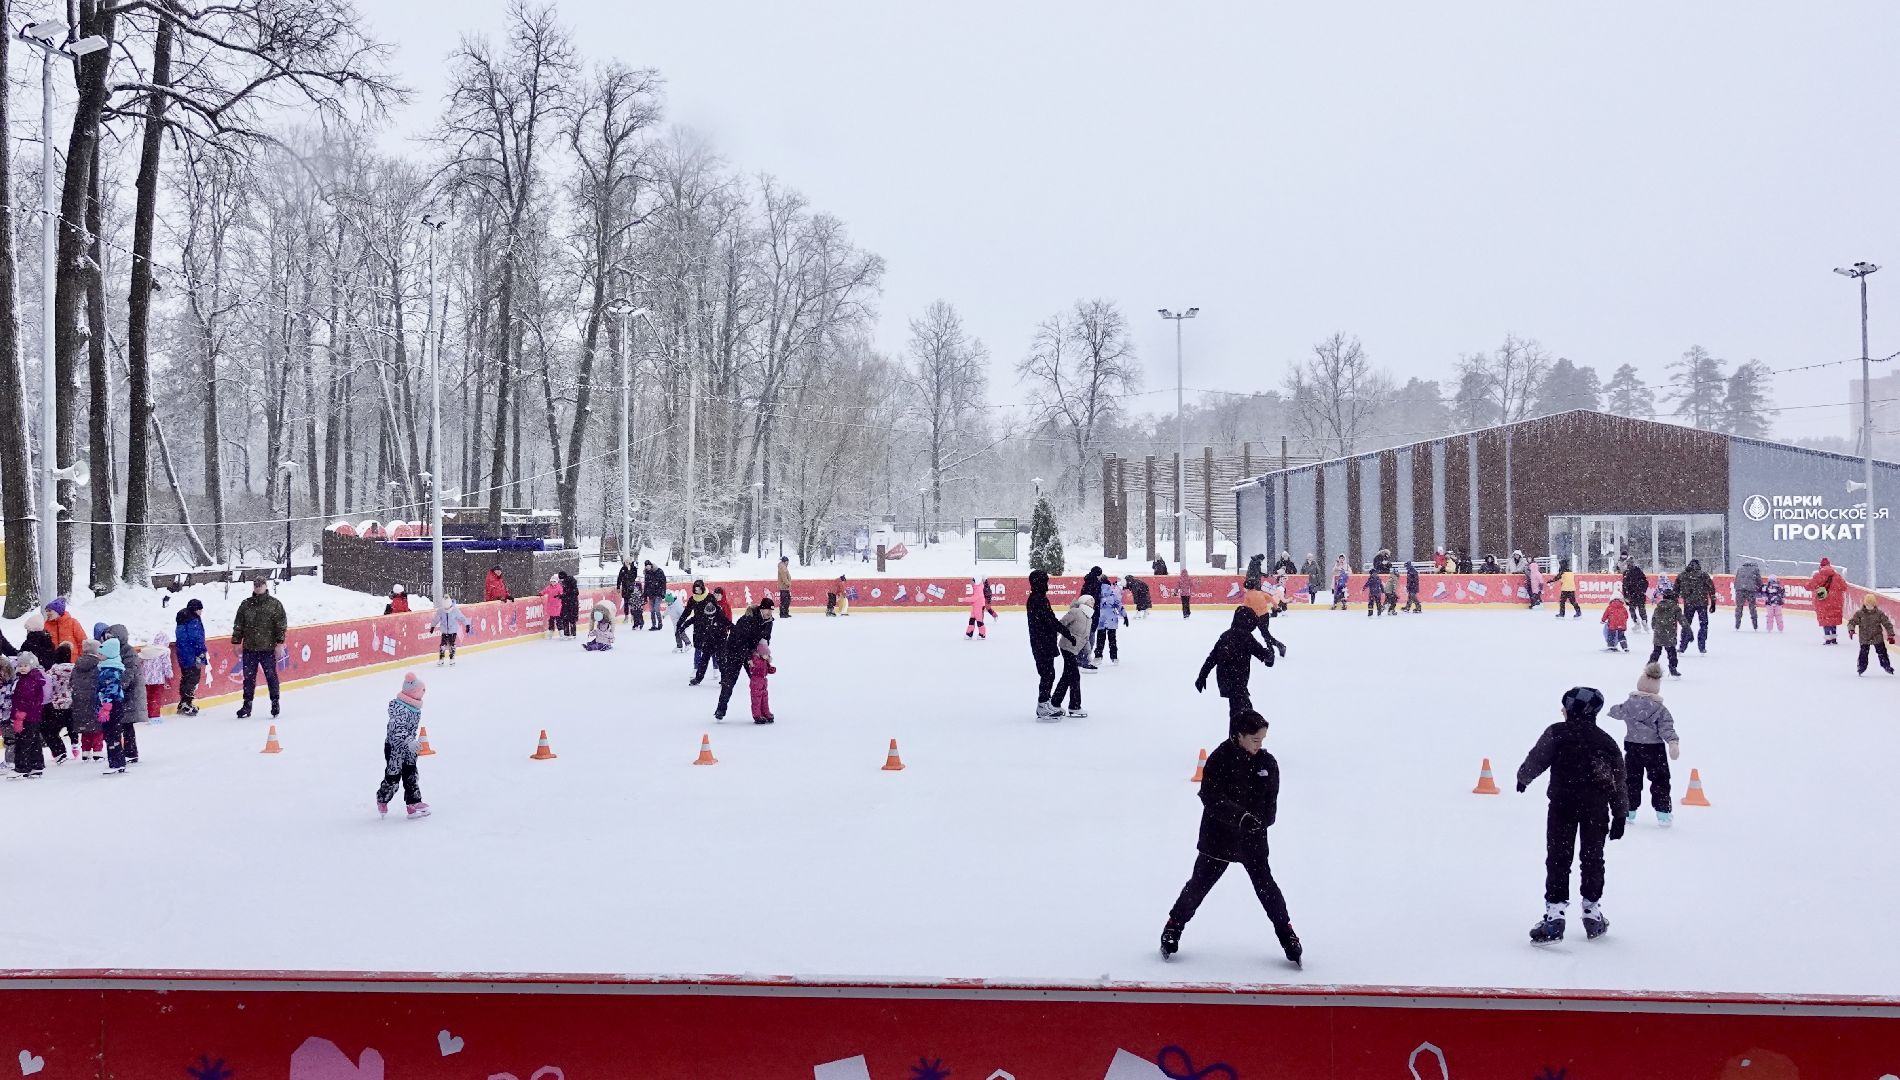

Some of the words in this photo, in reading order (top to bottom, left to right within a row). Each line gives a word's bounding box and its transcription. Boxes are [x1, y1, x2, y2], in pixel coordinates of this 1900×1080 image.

[1773, 495, 1822, 507] ПАРКИ
[1773, 523, 1865, 541] ПРОКАТ
[326, 630, 359, 653] ЗИМА
